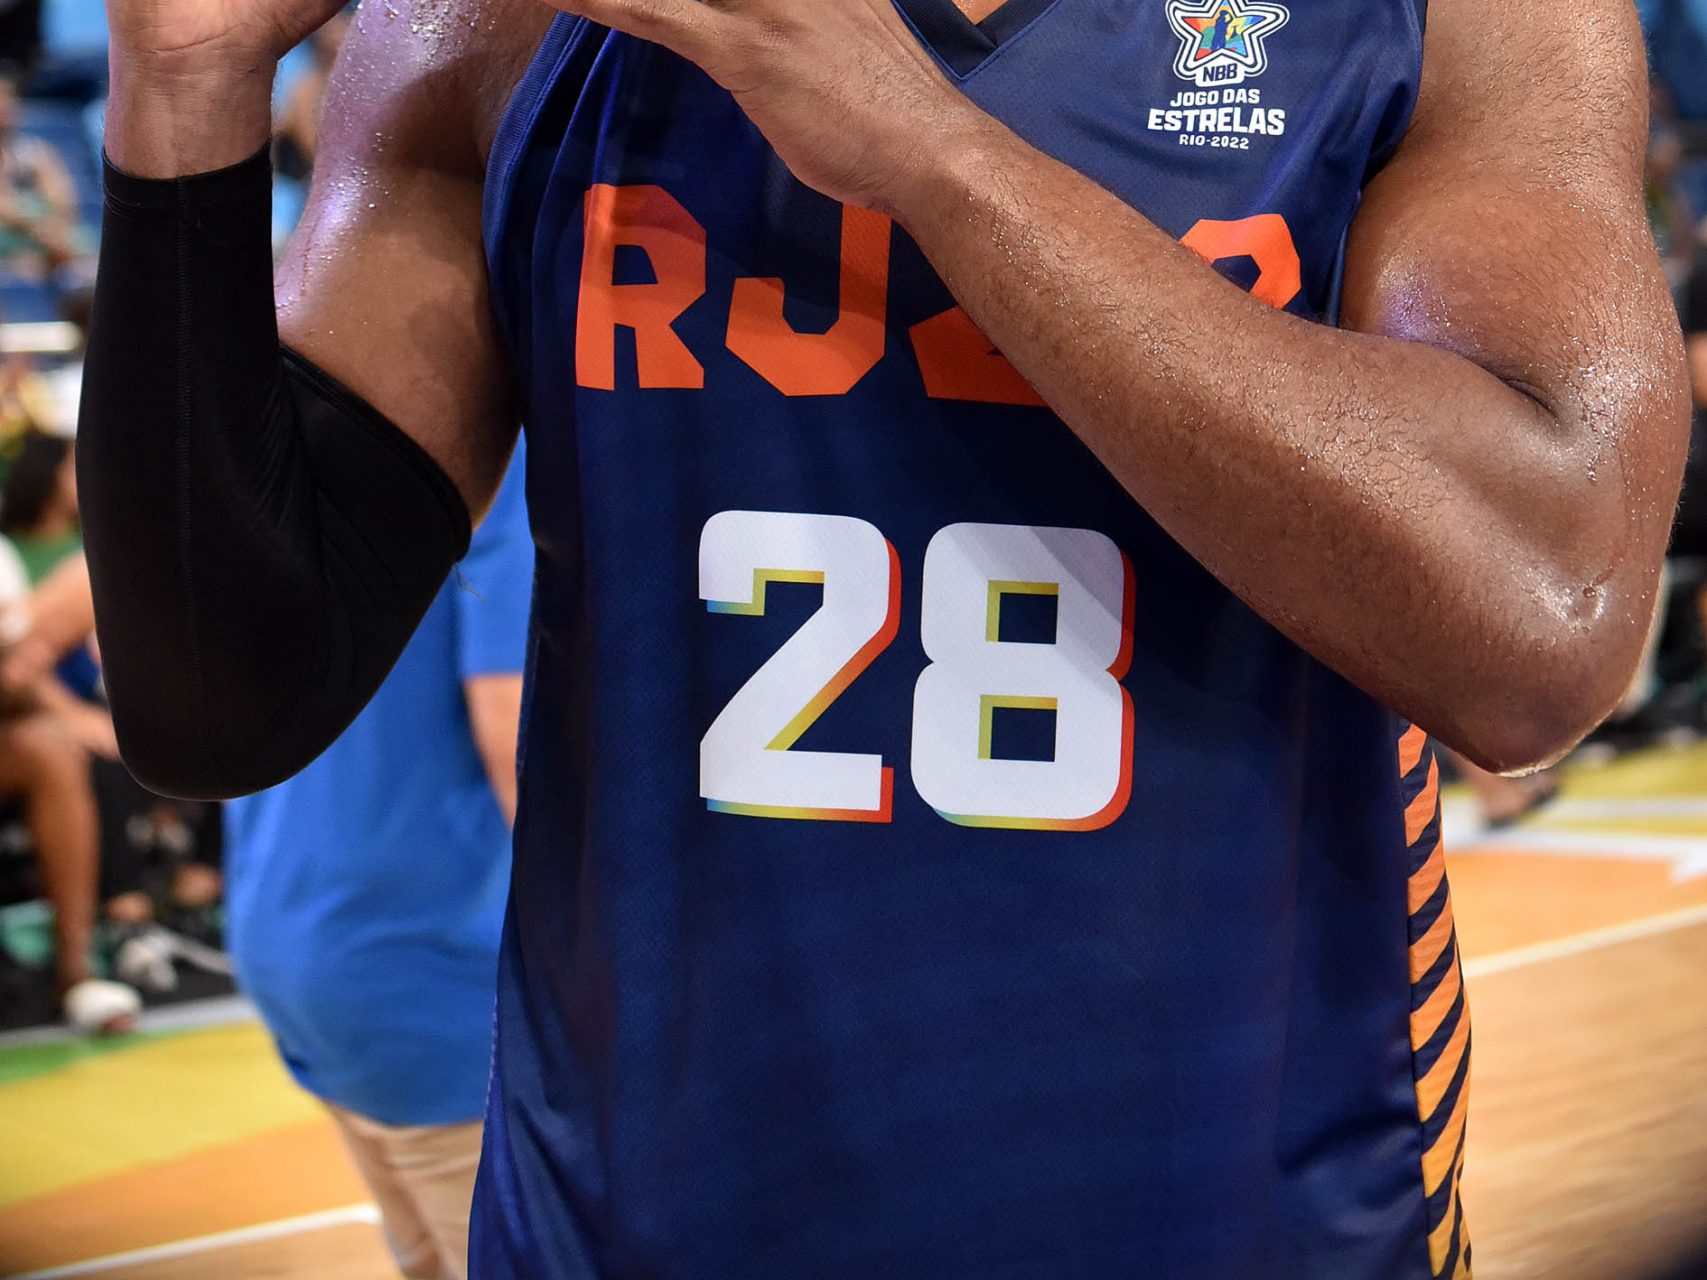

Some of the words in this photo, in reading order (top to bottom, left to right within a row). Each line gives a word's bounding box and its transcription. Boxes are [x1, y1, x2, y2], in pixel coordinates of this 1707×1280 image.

[1202, 62, 1238, 83] NBB
[1170, 90, 1219, 107] JOGO
[1222, 88, 1261, 104] DAS
[1147, 107, 1286, 135] ESTRELAS
[1179, 134, 1250, 150] RIO-2022
[699, 510, 1136, 832] 28
